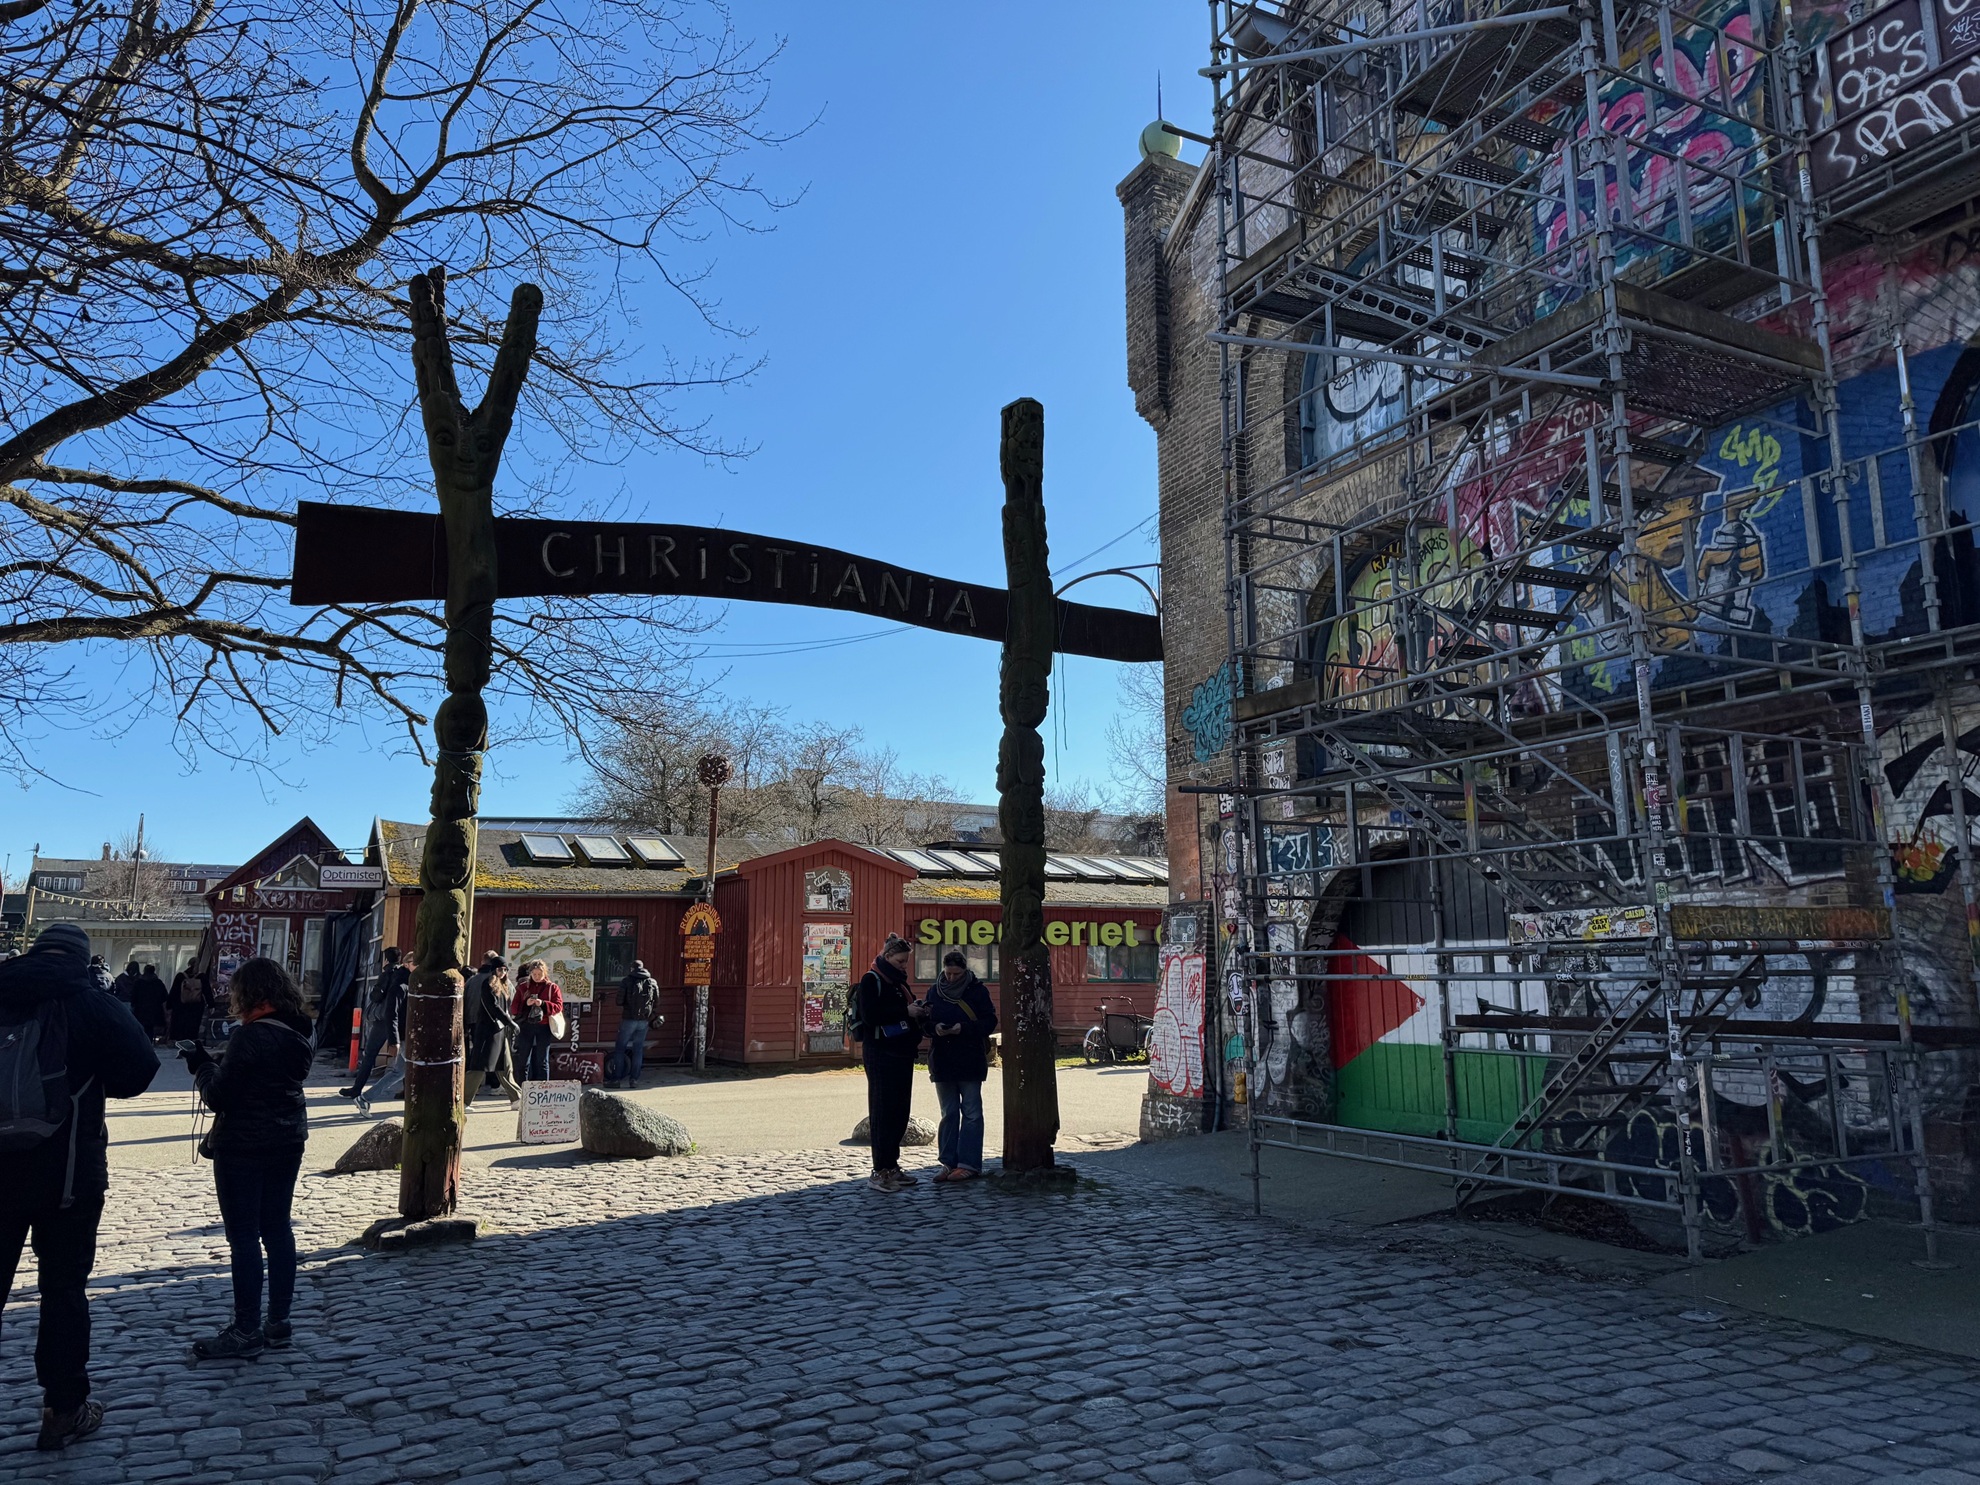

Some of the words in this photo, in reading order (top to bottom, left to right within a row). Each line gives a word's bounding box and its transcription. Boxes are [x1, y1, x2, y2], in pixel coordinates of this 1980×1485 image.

[322, 869, 382, 881] Optimisten
[680, 902, 722, 929] RUNDVISNING
[919, 919, 1139, 947] sneeriet
[528, 1090, 576, 1106] SPÅMAND
